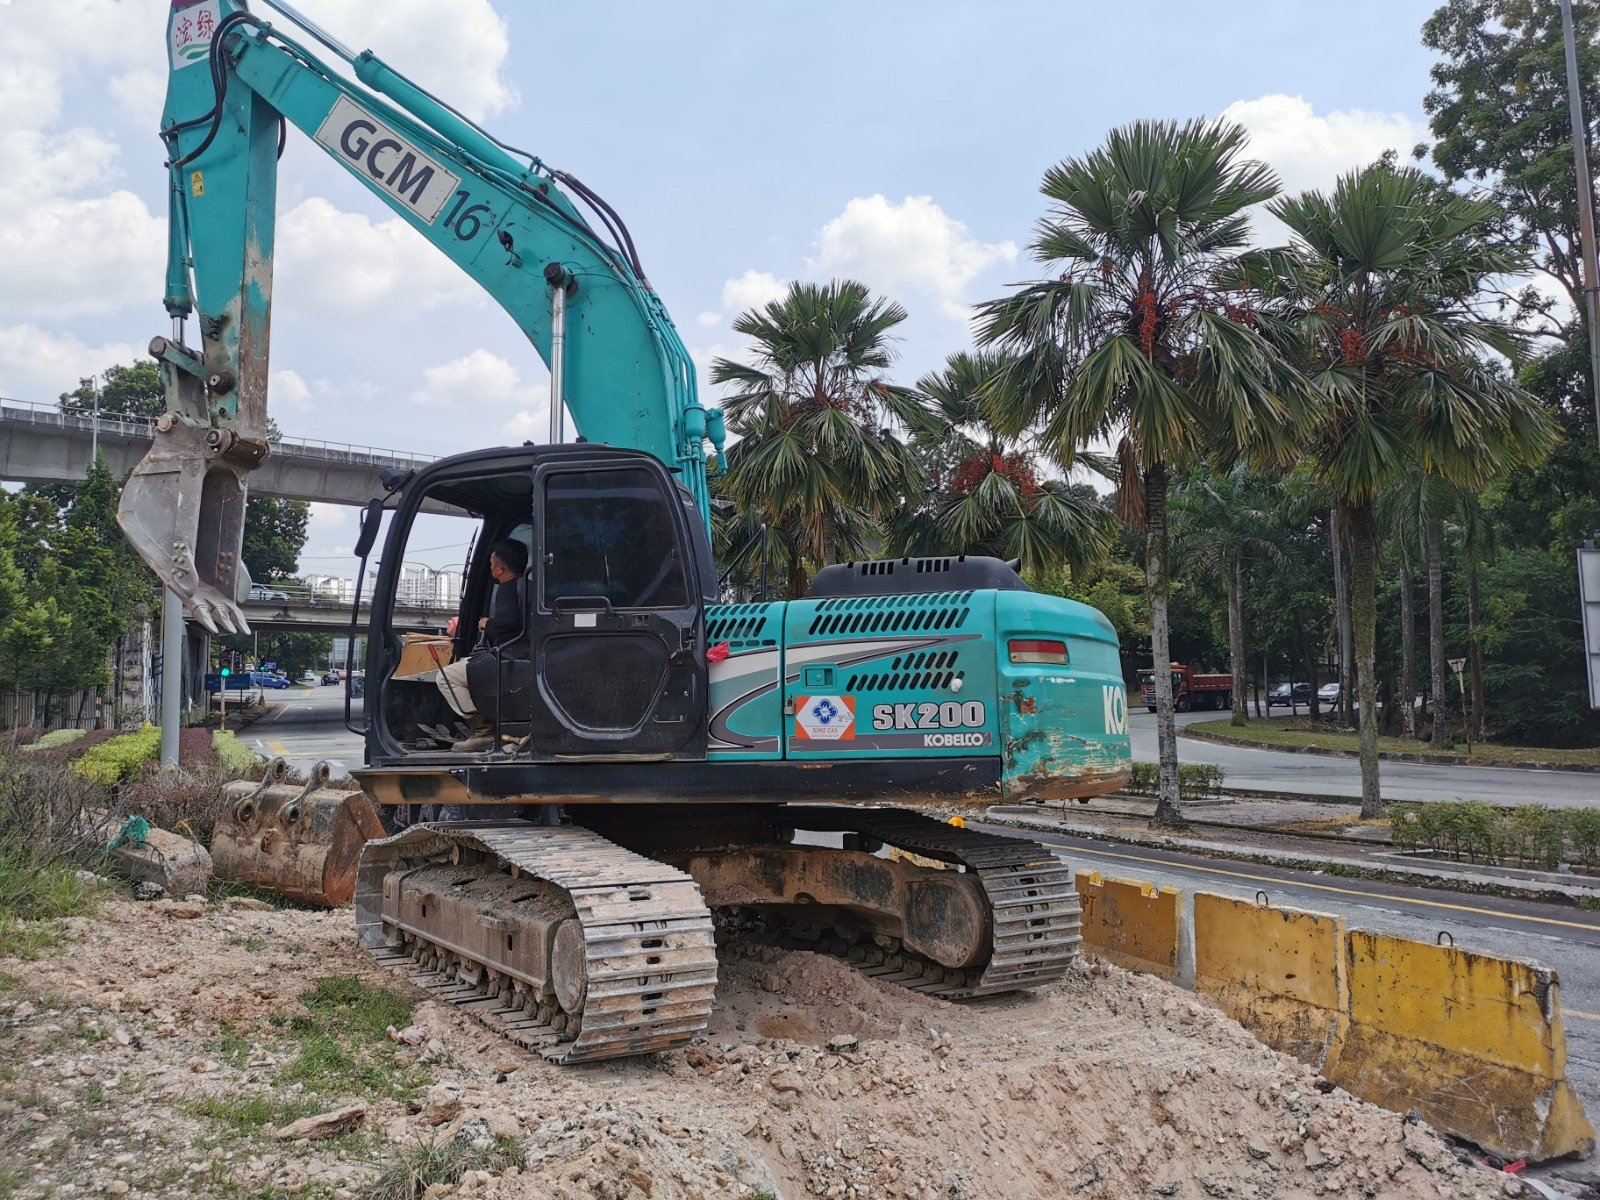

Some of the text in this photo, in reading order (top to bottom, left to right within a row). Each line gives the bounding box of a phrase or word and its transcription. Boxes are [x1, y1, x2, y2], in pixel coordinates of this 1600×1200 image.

[340, 119, 490, 241] GCM 16
[873, 700, 985, 731] SK200
[924, 732, 984, 748] KOBELCO
